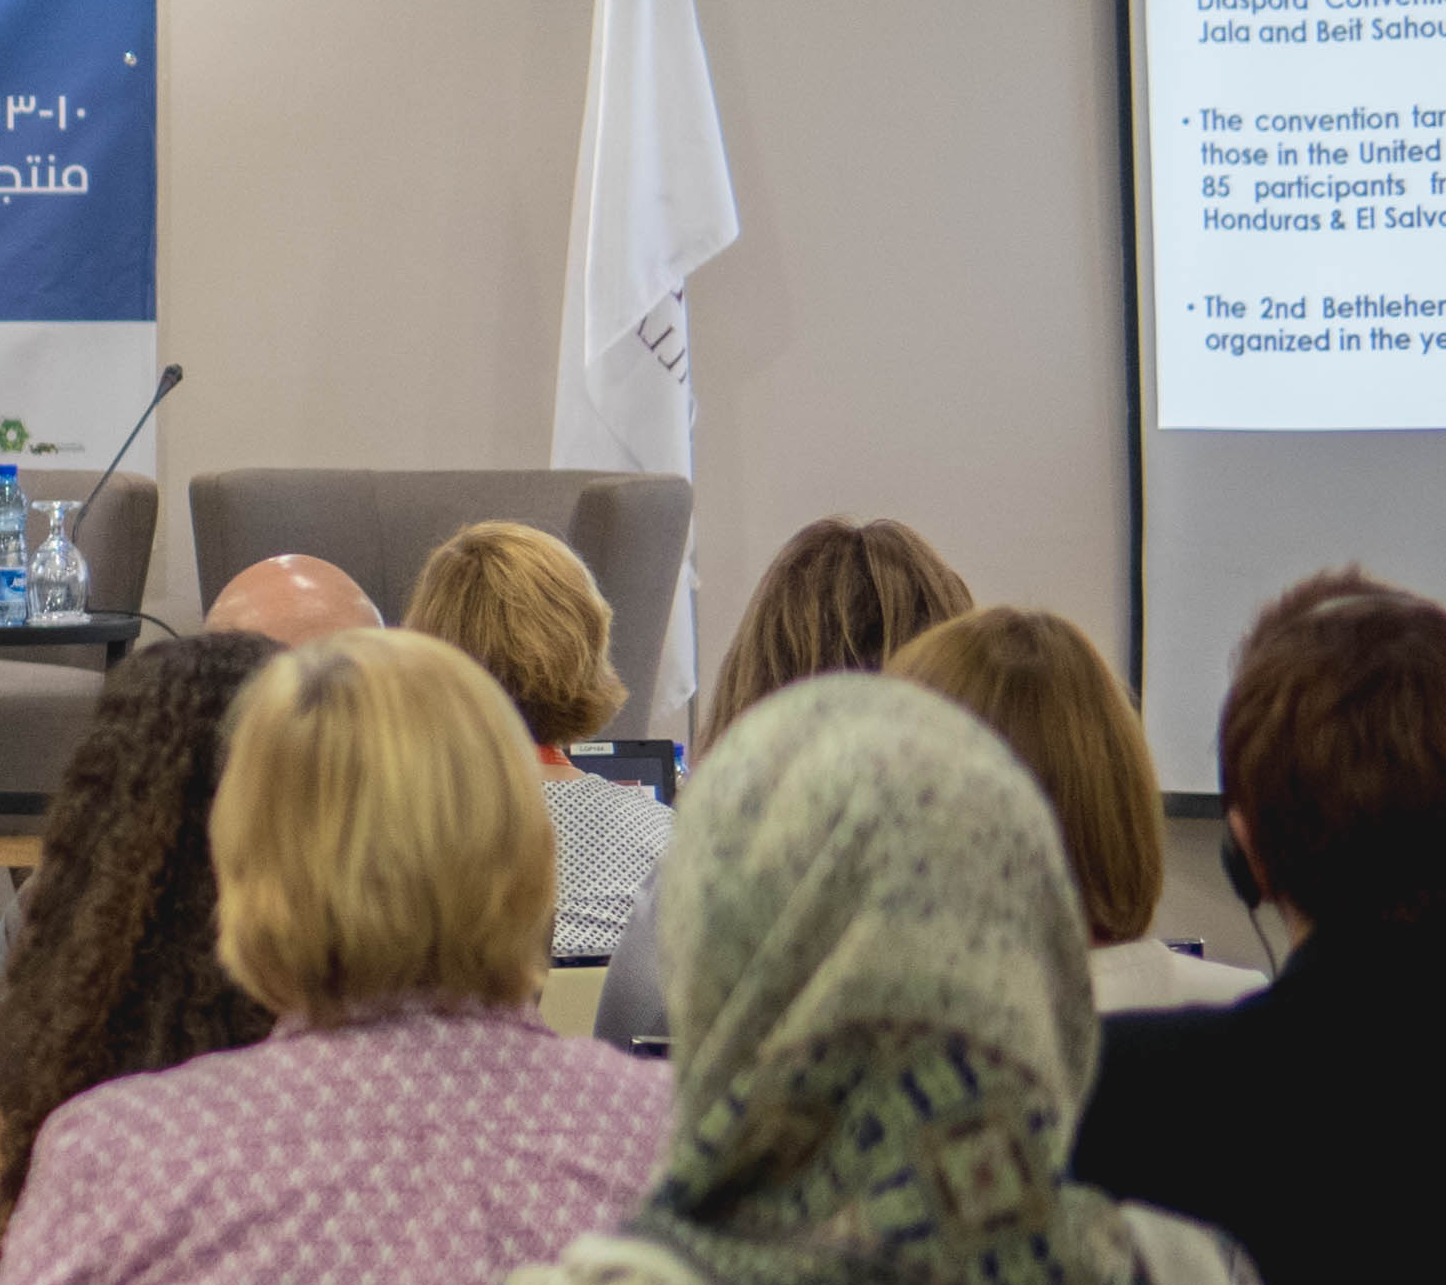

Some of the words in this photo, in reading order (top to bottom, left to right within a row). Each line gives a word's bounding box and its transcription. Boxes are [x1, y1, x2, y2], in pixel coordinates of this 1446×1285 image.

[1199, 19, 1251, 43] Jala
[1259, 19, 1307, 43] and
[1316, 17, 1363, 43] Beit
[1201, 109, 1243, 131] The
[1255, 106, 1399, 132] convention
[1201, 142, 1268, 165] those
[1278, 141, 1298, 165] in
[1309, 141, 1349, 165] the
[1359, 138, 1442, 164] United
[1202, 175, 1230, 198] 85
[1255, 173, 1406, 202] participants
[1204, 208, 1321, 232] Honduras
[1330, 209, 1346, 230] &
[1356, 207, 1375, 230] El
[1204, 295, 1247, 319] The
[1260, 296, 1306, 320] 2nd
[1205, 328, 1331, 357] organized
[1340, 328, 1361, 351] in
[1370, 327, 1411, 350] the
